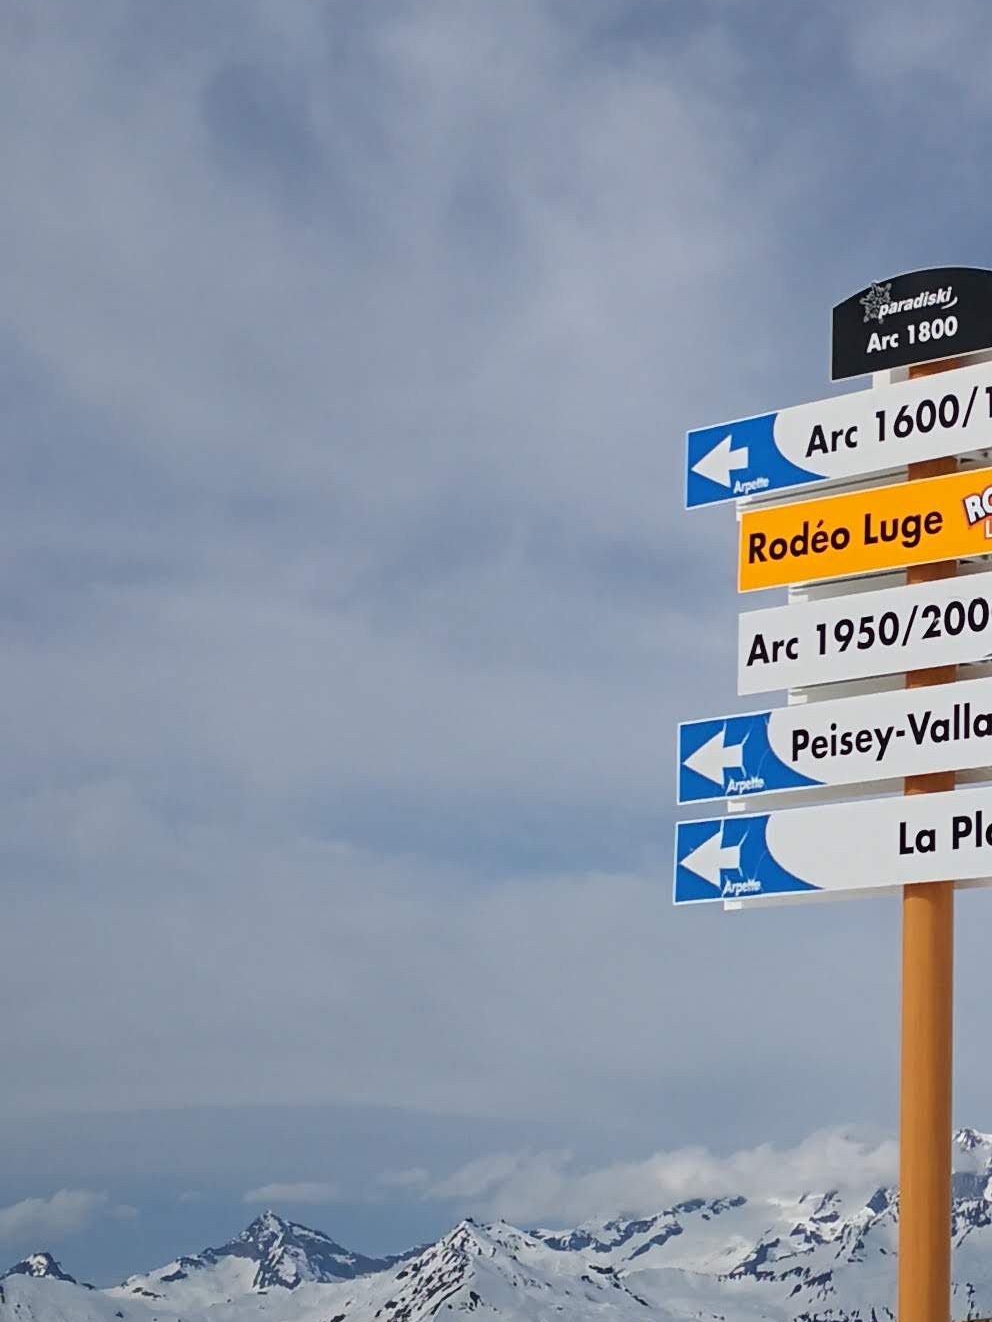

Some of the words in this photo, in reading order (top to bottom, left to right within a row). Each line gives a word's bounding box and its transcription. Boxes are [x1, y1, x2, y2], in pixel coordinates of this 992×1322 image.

[877, 285, 955, 320] paradiski
[866, 331, 899, 353] Arc
[906, 316, 958, 344] 1800
[806, 424, 858, 458] Arc
[748, 520, 850, 564] Rodéo
[865, 508, 944, 549] Luge
[747, 633, 799, 666] Arc
[899, 822, 936, 855] La
